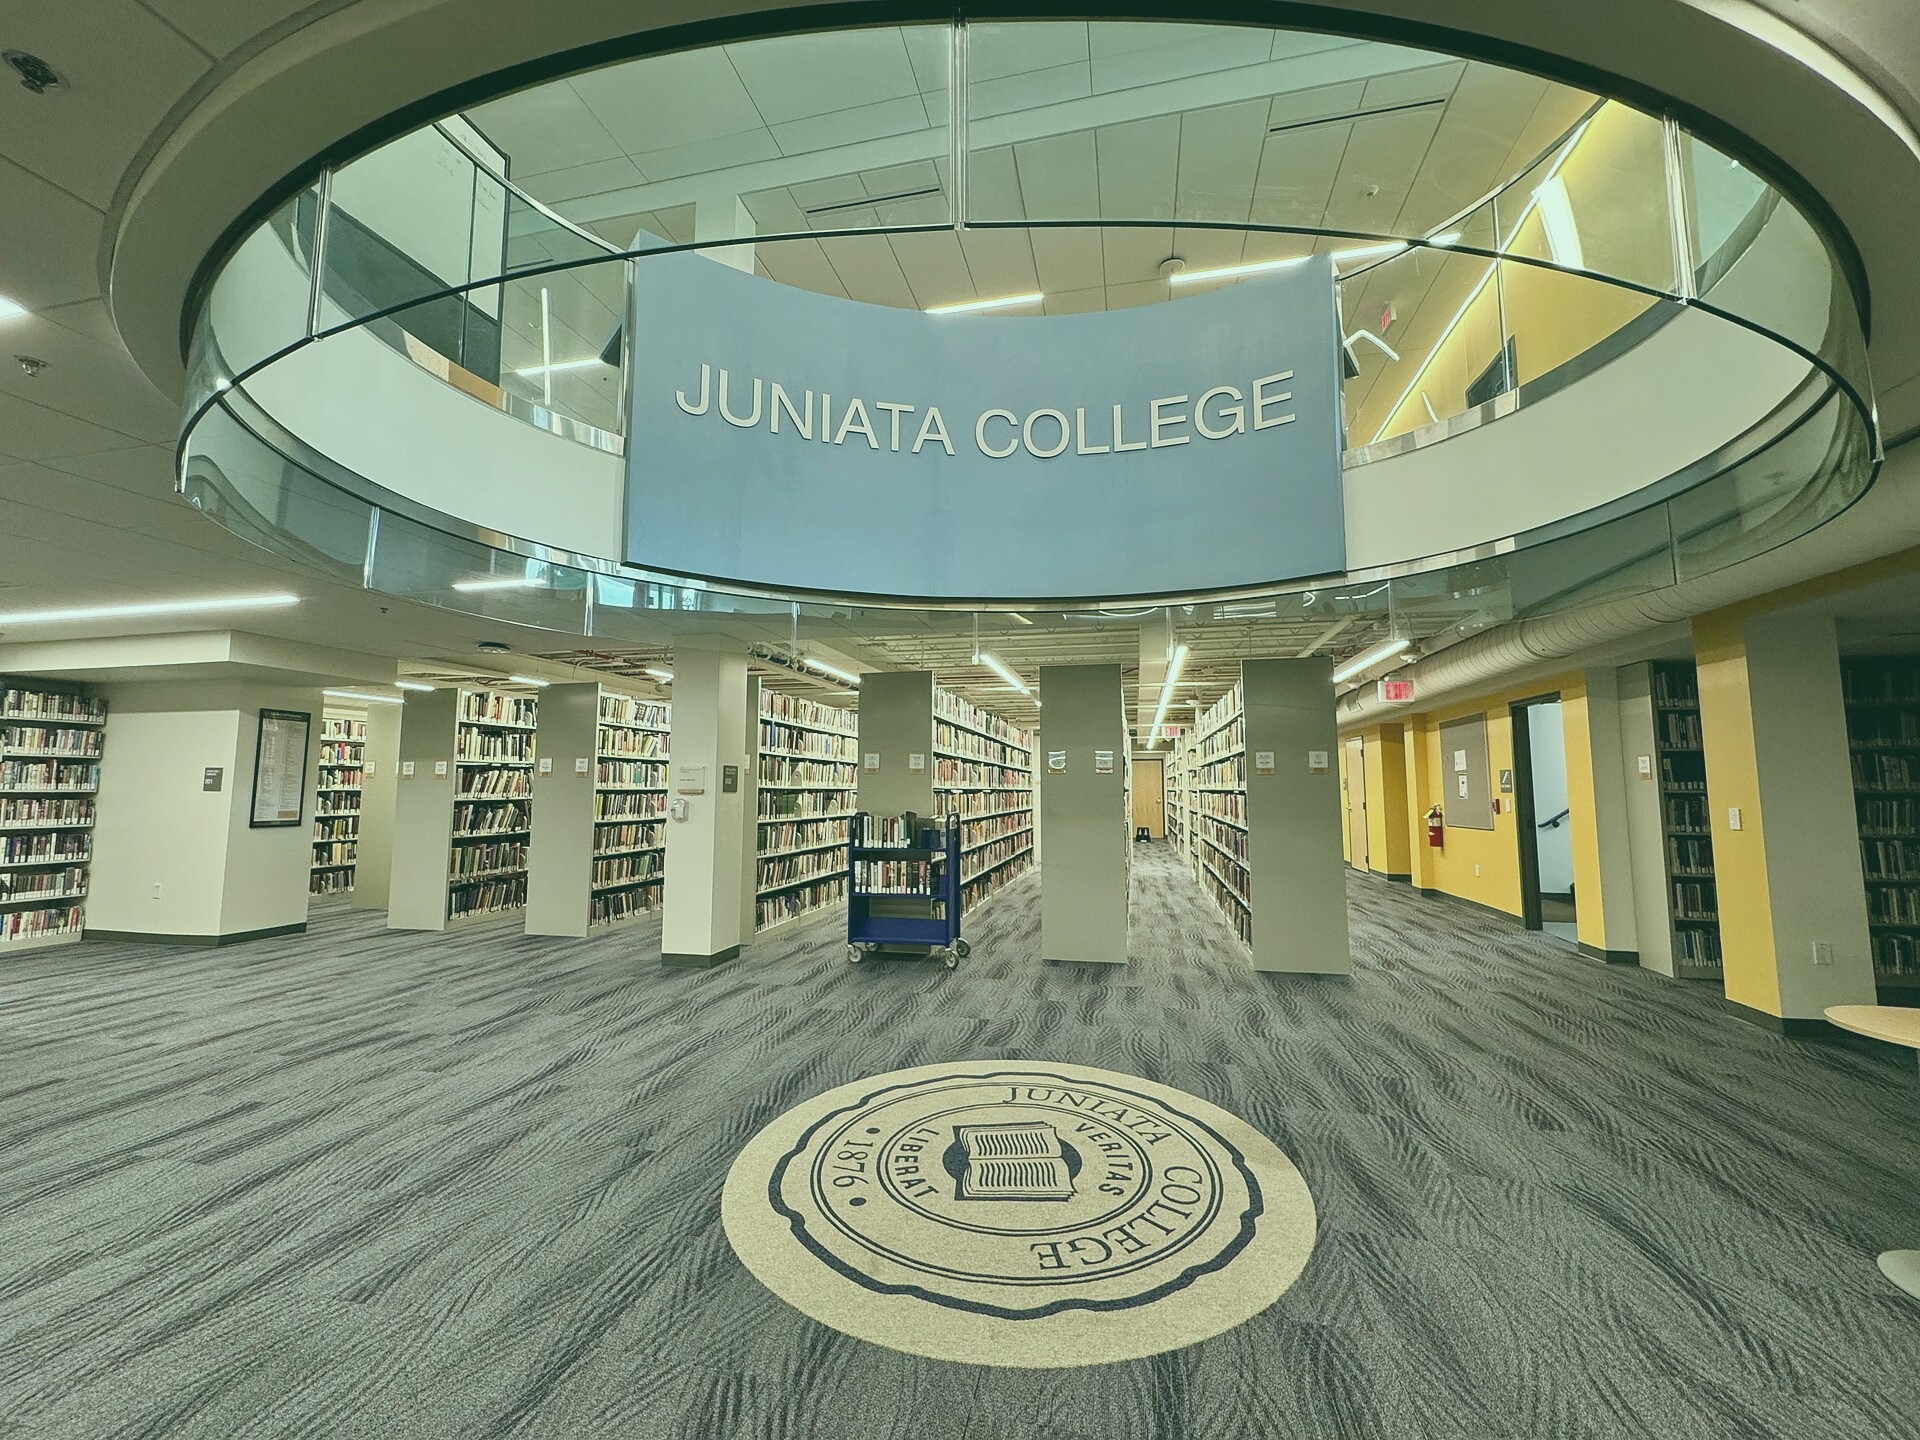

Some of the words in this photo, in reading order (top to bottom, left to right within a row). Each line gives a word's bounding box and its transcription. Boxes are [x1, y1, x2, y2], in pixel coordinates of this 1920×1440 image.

[674, 363, 956, 456] JUNIATA
[974, 369, 1297, 460] COLLEGE
[1002, 1087, 1172, 1146] JUNIATA
[832, 1139, 874, 1188] 1876
[894, 1127, 940, 1198] LIBERAT
[1075, 1122, 1134, 1197] VERITAS
[1030, 1165, 1203, 1270] COLLEGE
